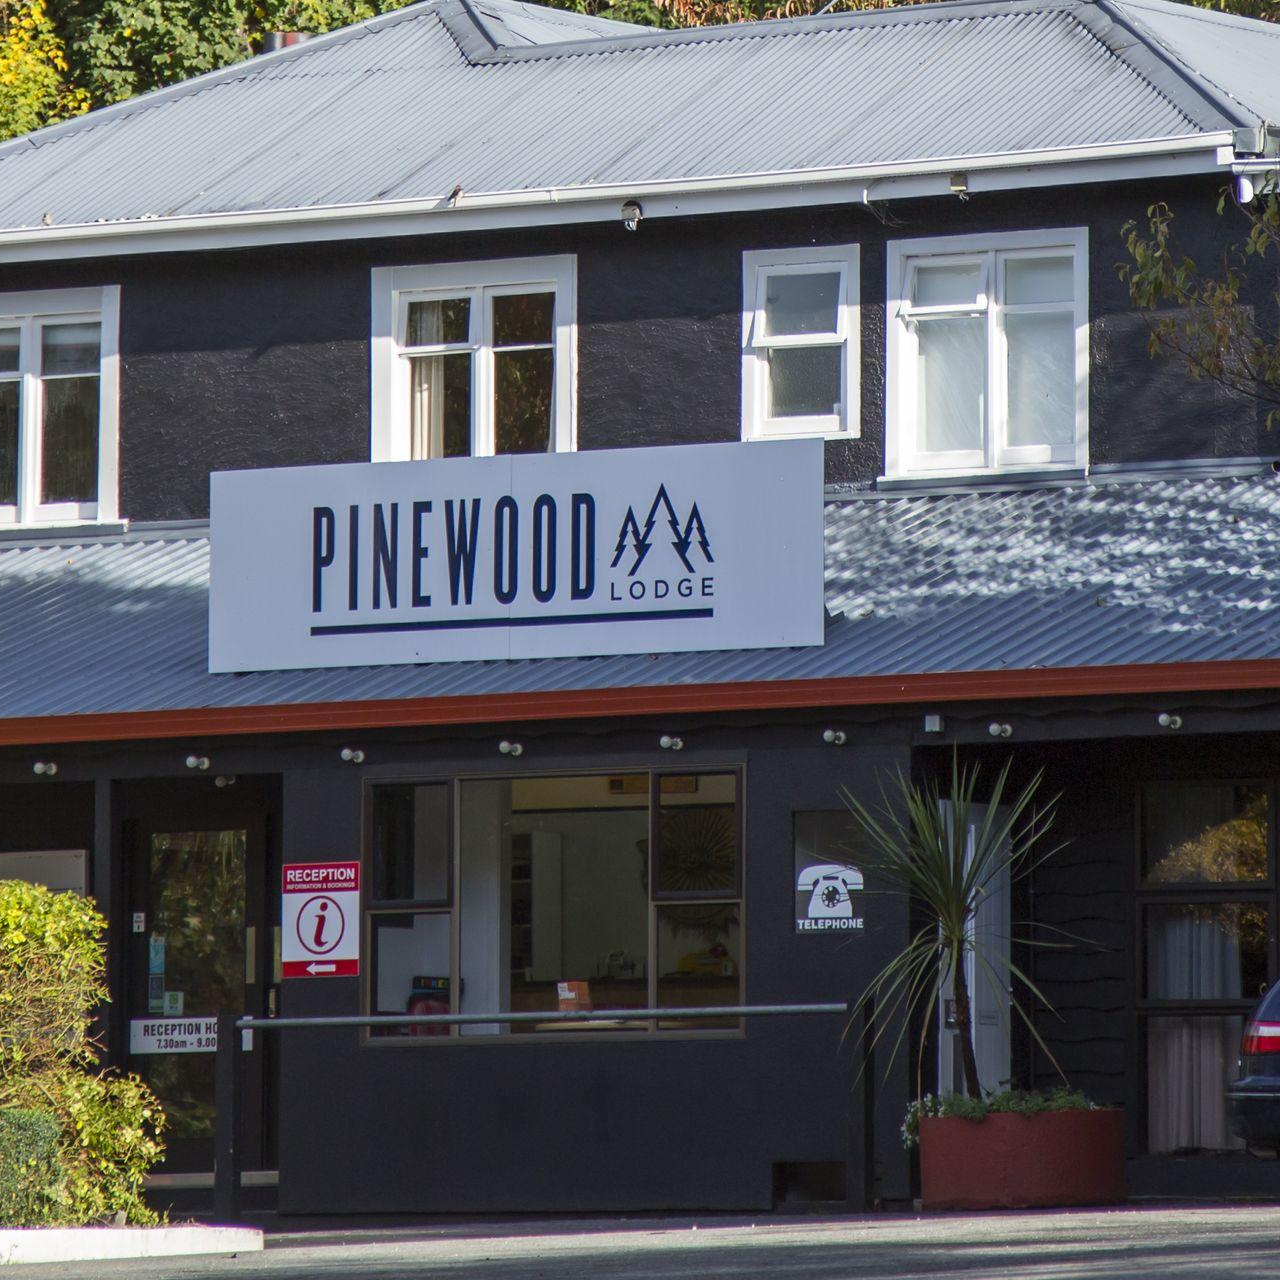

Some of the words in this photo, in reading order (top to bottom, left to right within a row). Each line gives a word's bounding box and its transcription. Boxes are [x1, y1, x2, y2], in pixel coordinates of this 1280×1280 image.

[312, 493, 596, 613] PINEWOOD
[610, 577, 714, 601] LODGE
[286, 868, 355, 882] RECEPTION
[797, 919, 864, 929] TELEPHONE
[143, 1023, 202, 1036] RECEPTION
[156, 1039, 187, 1049] 7.30am
